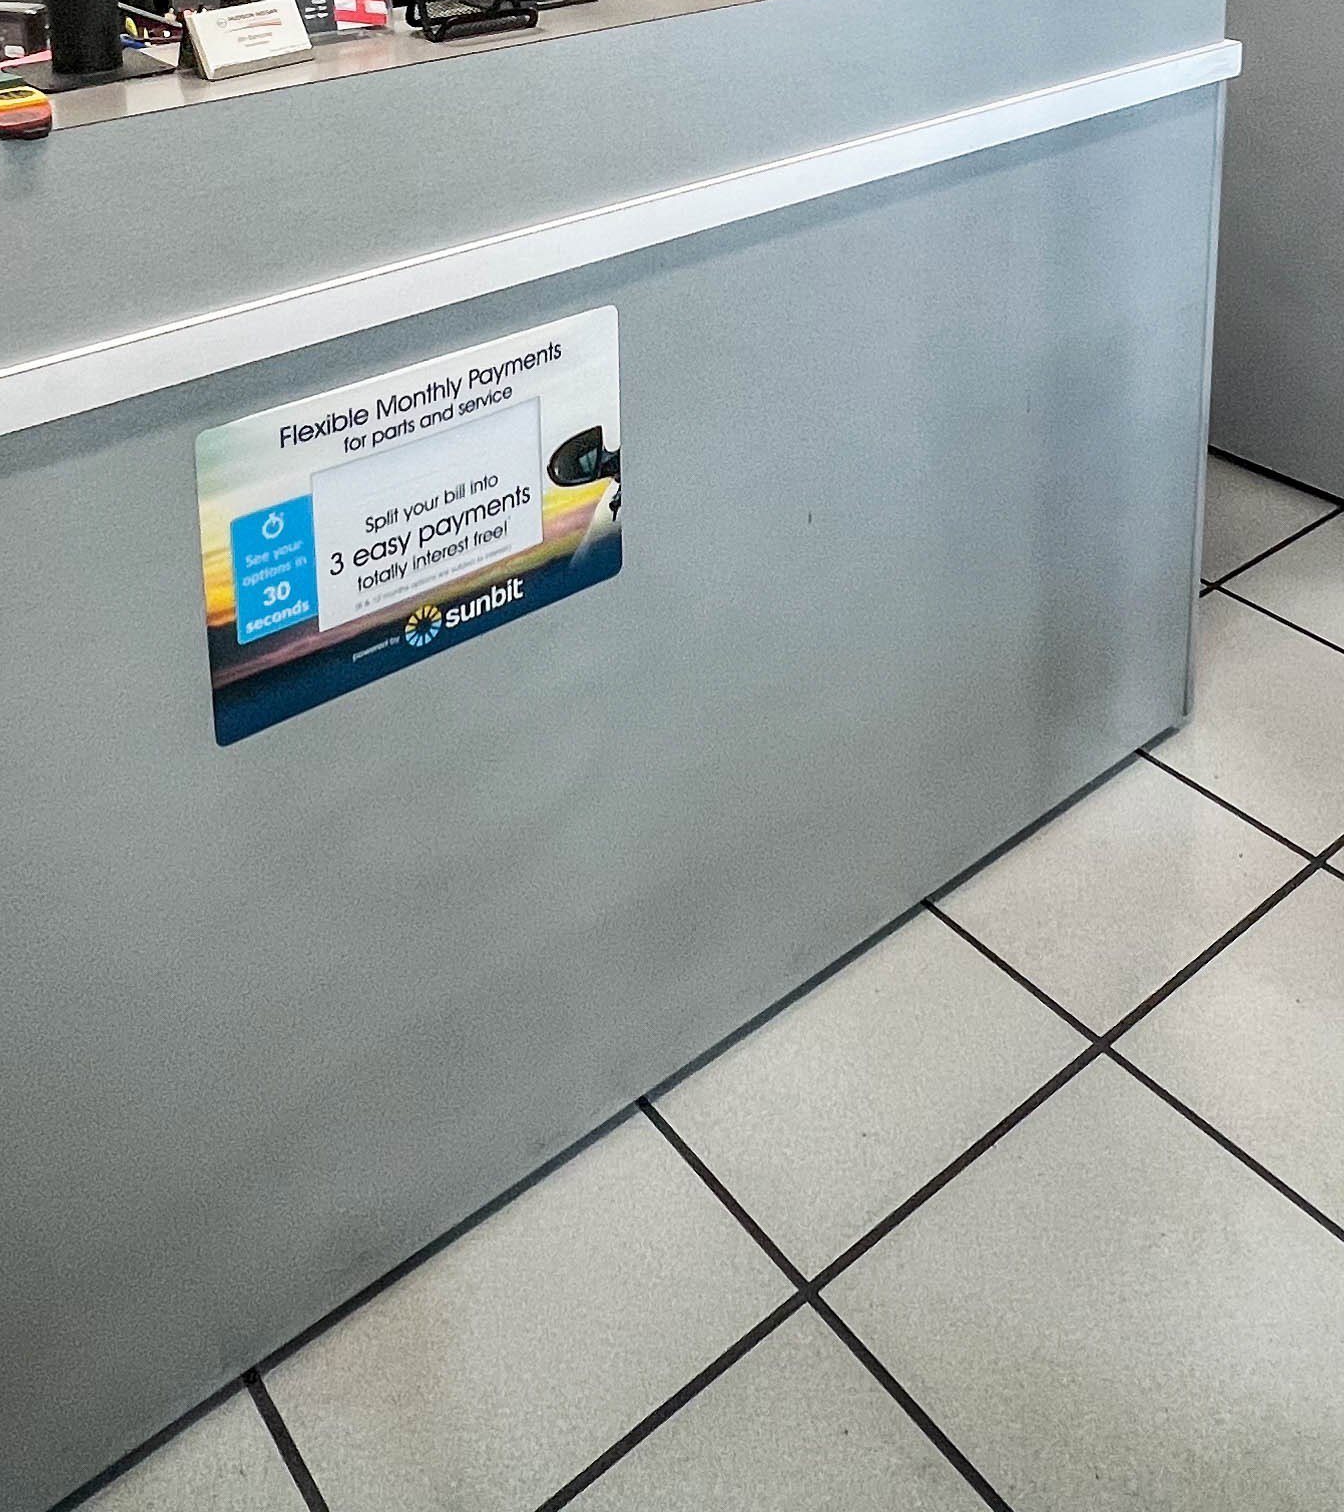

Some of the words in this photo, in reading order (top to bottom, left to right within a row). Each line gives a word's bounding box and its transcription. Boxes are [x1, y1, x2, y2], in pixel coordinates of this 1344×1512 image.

[280, 407, 369, 448] Flexible
[376, 376, 462, 420] Monthly
[468, 341, 562, 389] Payments
[344, 435, 367, 453] for
[372, 418, 415, 448] parts
[420, 403, 454, 429] and
[458, 385, 513, 416] service
[365, 509, 399, 534] Split
[403, 495, 439, 523] your
[444, 483, 466, 505] bill
[470, 474, 499, 494] into
[245, 550, 270, 569] See
[272, 539, 304, 561] your
[329, 551, 345, 576] 3
[353, 530, 411, 567] easy
[419, 485, 531, 548] payments
[242, 561, 292, 587] options
[294, 555, 308, 569] in
[357, 562, 408, 592] totally
[412, 539, 469, 570] interest
[245, 599, 311, 634] seconds
[263, 580, 292, 607] 30
[444, 577, 524, 629] sunbit
